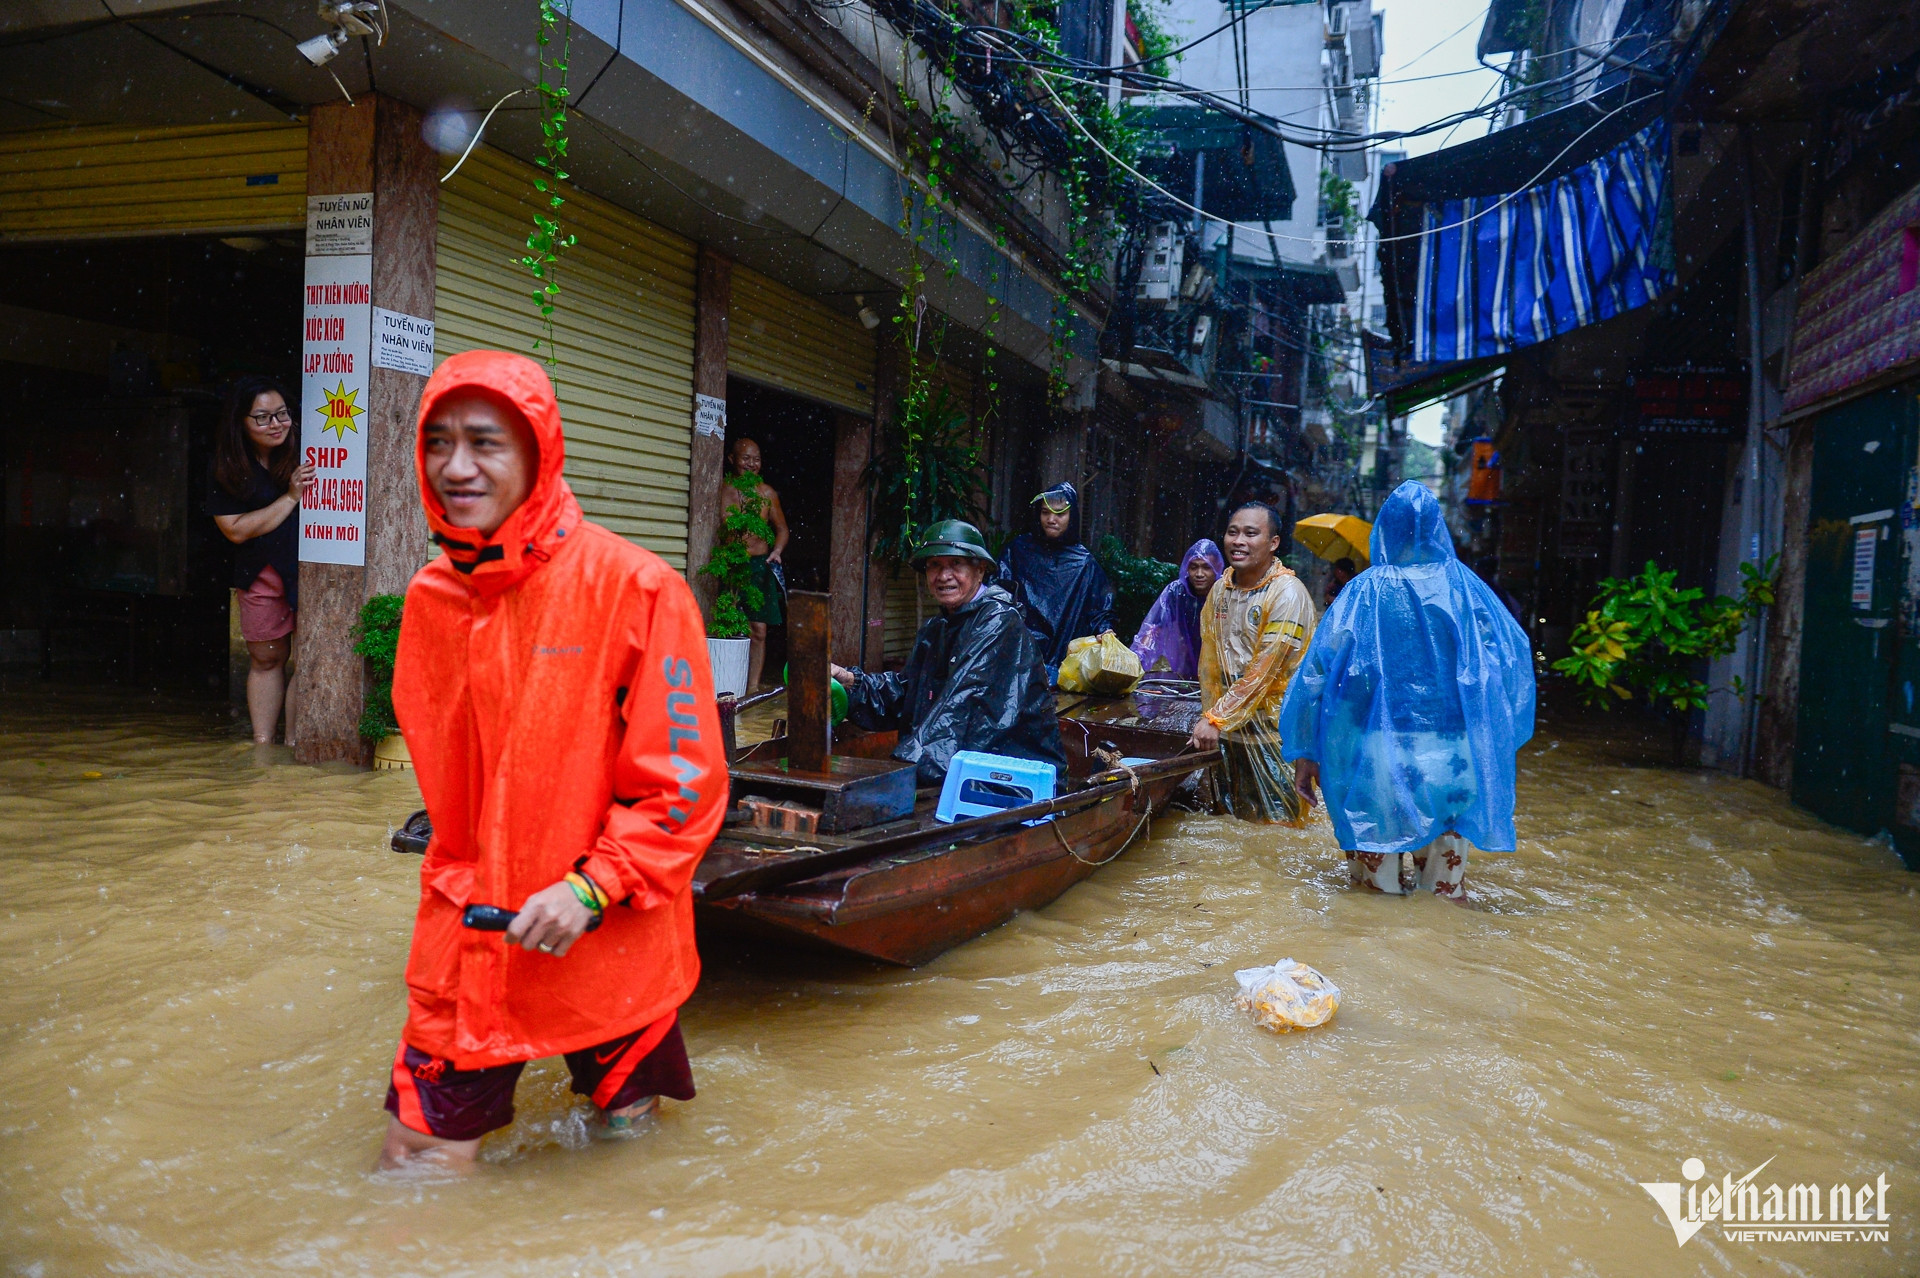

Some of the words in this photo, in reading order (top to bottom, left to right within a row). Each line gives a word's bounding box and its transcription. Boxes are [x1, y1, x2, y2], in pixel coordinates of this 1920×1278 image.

[319, 196, 350, 211] TUYỂN
[352, 197, 370, 210] NỮ
[316, 216, 345, 229] NHÂN
[347, 215, 370, 228] VIÊN
[306, 285, 323, 308] THỊT
[305, 314, 322, 341] XÚC
[324, 314, 344, 341] XÍCH
[384, 315, 414, 332] TUYỂN
[416, 323, 431, 336] NỮ
[382, 333, 409, 348] NHÂN
[411, 340, 432, 353] VIÊN
[304, 353, 321, 377] LẠP
[323, 347, 353, 373] XƯỞNG
[305, 447, 348, 469] SHIP
[302, 477, 364, 513] 083.443.9669
[305, 522, 332, 540] KÍNH
[336, 523, 359, 541] MỜI
